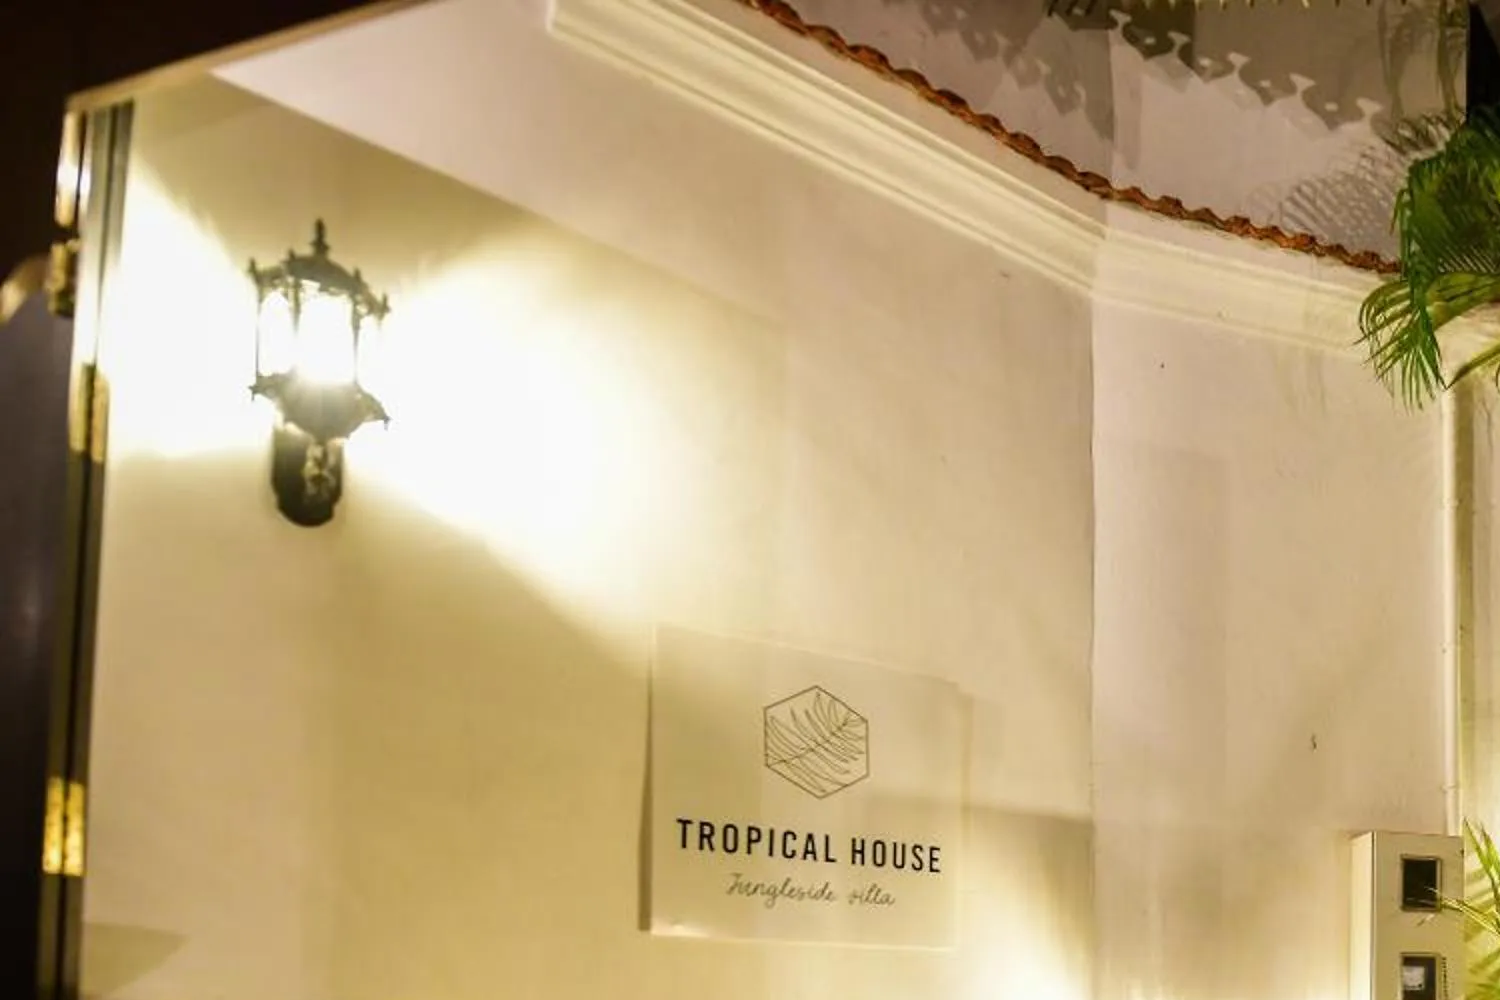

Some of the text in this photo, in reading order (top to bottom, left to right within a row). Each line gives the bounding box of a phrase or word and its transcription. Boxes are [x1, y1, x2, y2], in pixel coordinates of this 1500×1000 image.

[676, 817, 942, 873] TROPICAL HOUSE
[726, 872, 835, 909] Jungleside
